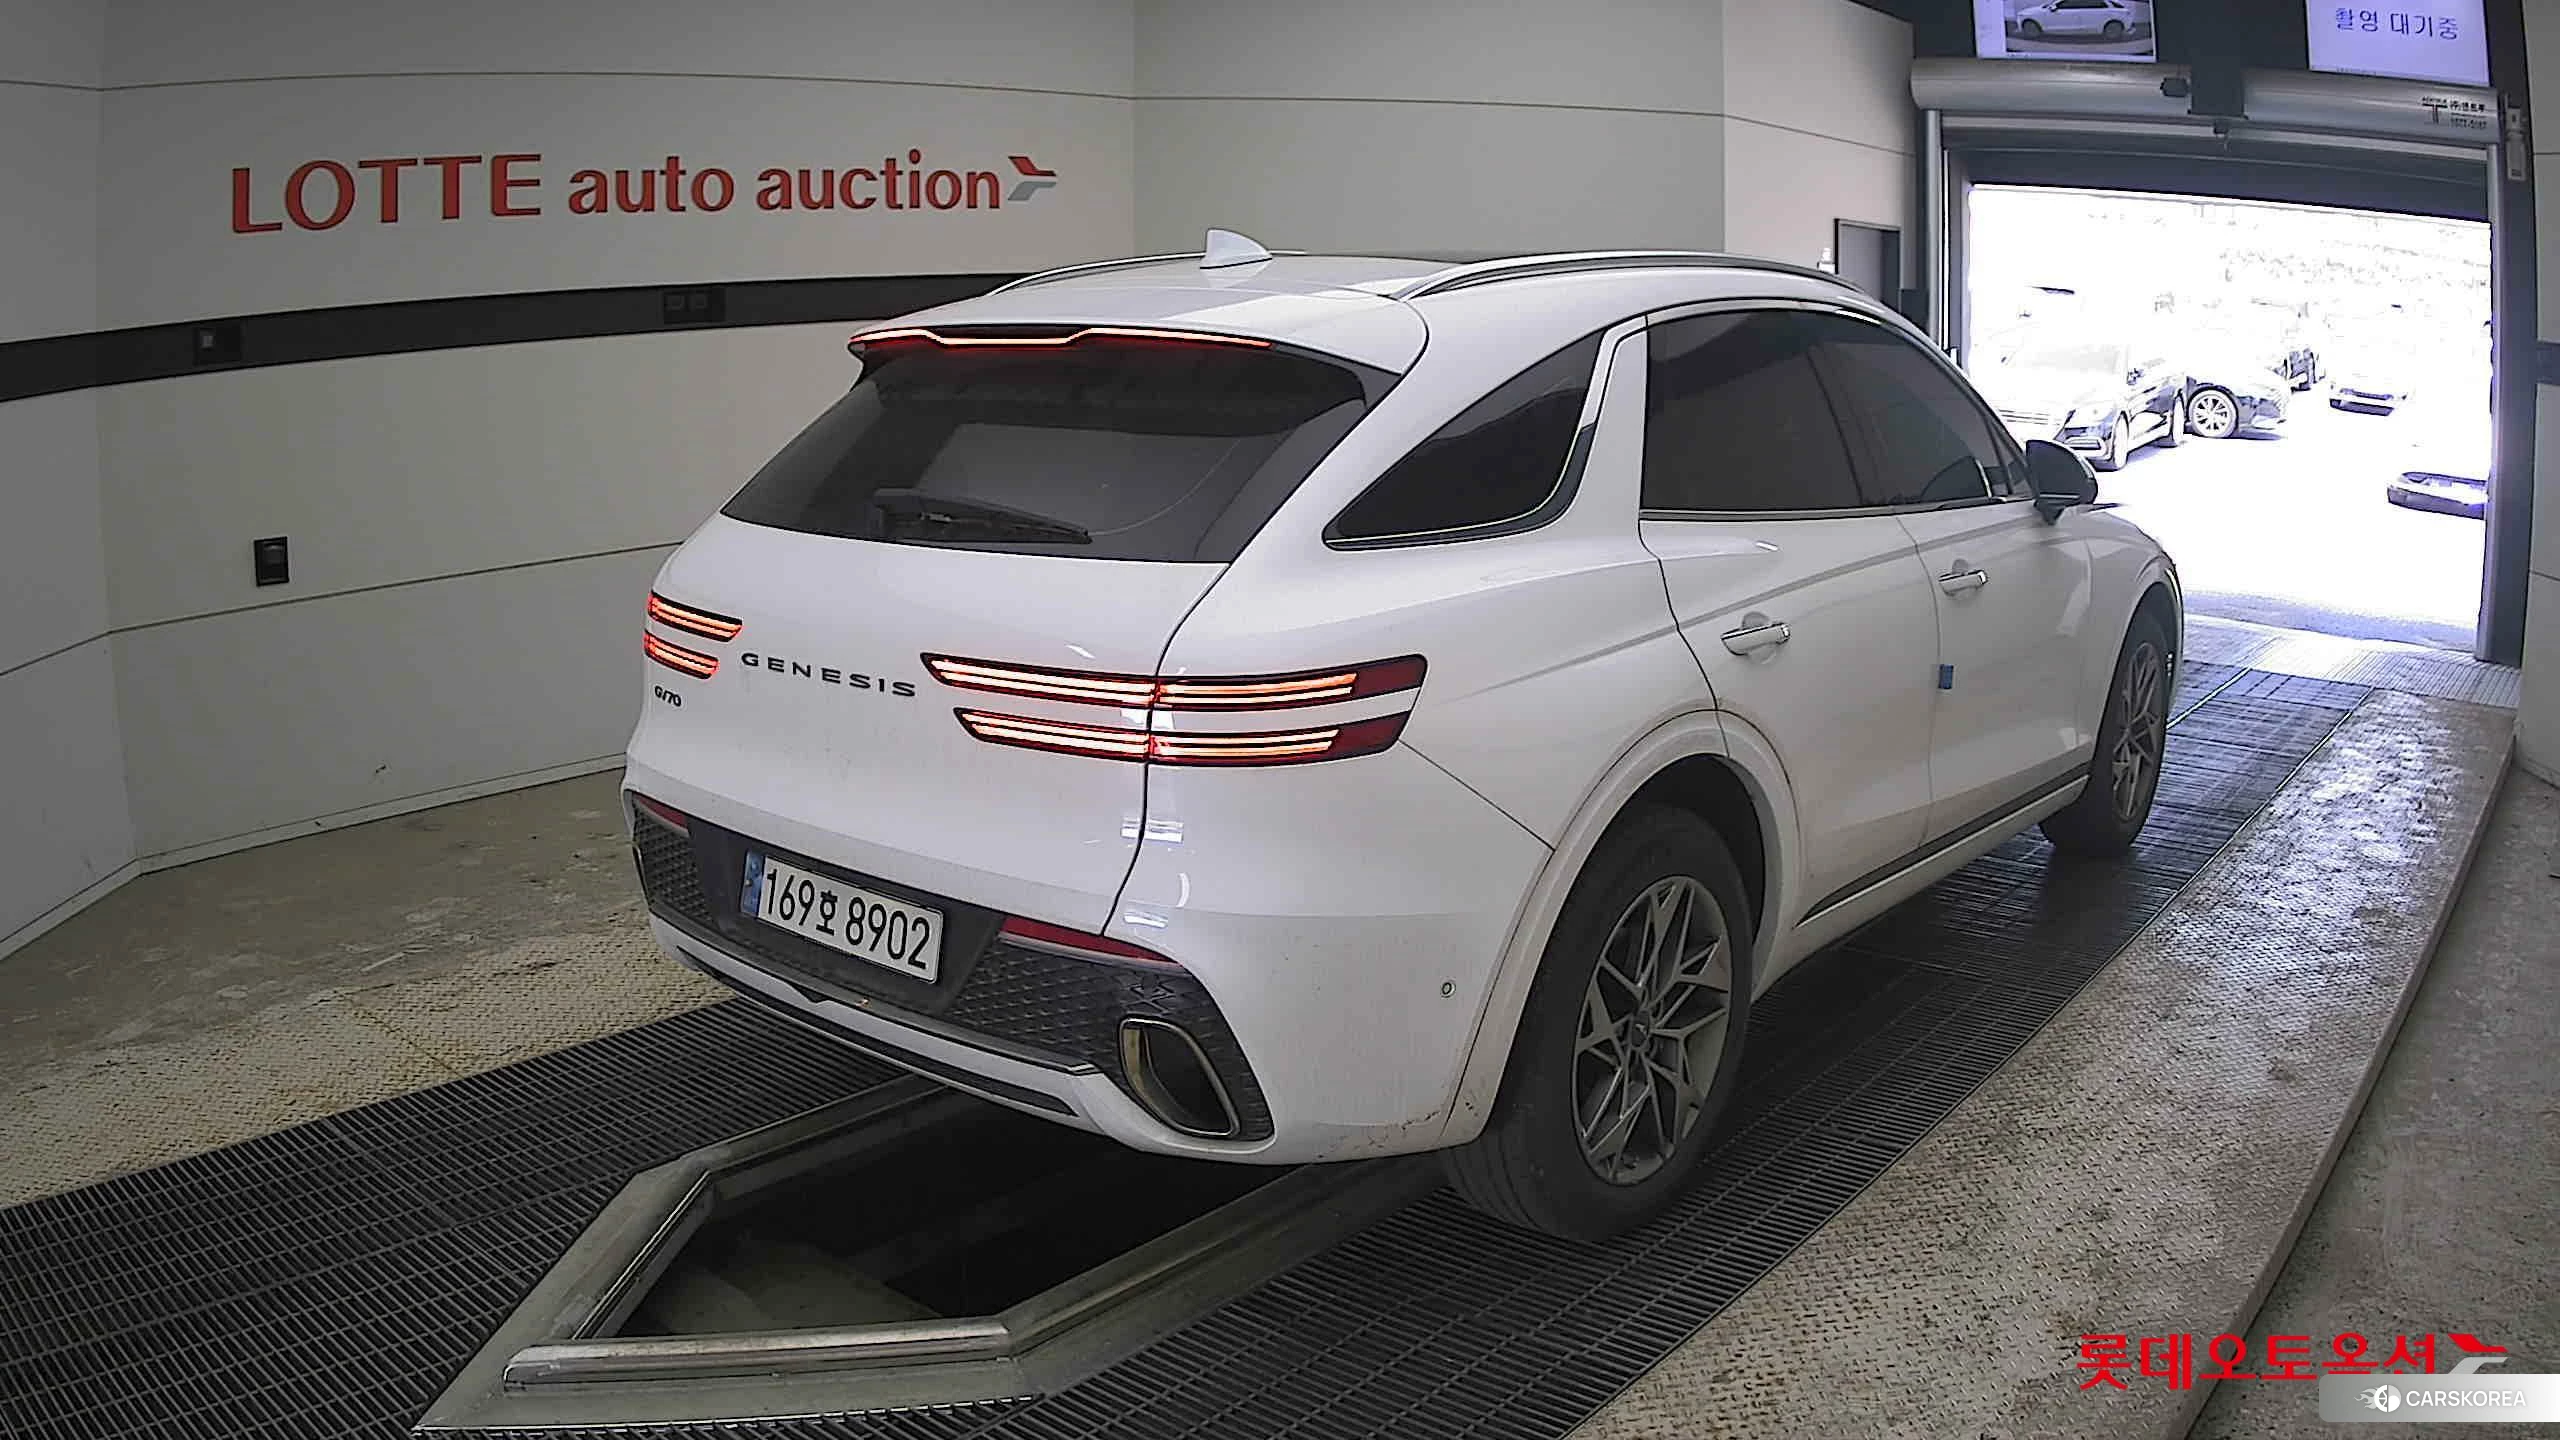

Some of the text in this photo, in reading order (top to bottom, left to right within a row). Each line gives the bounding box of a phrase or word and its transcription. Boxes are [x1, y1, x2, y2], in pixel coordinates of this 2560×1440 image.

[2335, 8, 2458, 40] 촬영 대기중
[232, 149, 1002, 234] LOTTE auto auction
[741, 652, 916, 697] GENESIS
